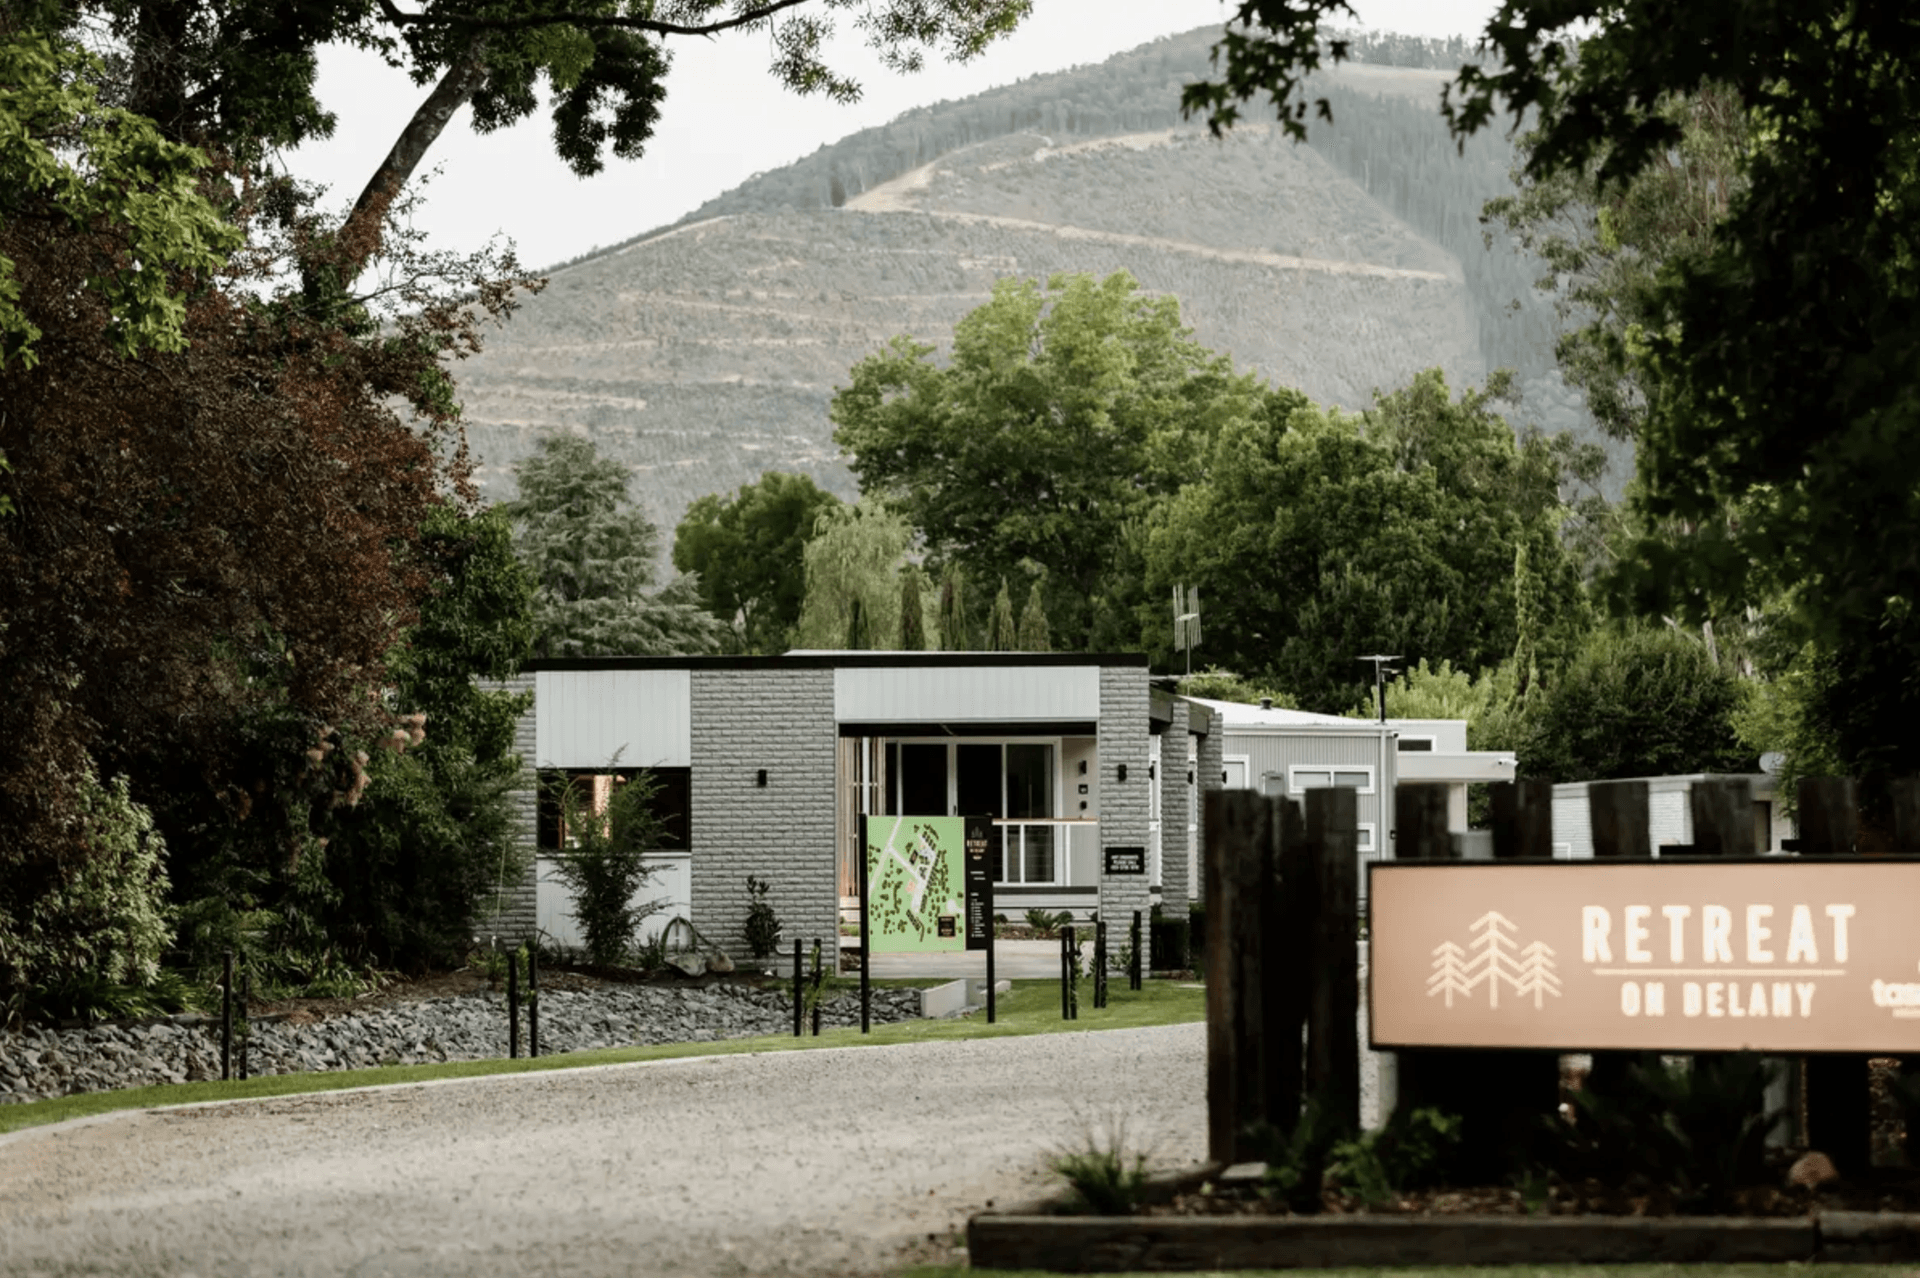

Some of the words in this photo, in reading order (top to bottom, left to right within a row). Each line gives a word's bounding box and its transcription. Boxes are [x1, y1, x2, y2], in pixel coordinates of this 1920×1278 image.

[1581, 904, 1856, 963] RETREAT
[1620, 981, 1665, 1017] ON
[1682, 981, 1816, 1018] DELANY
